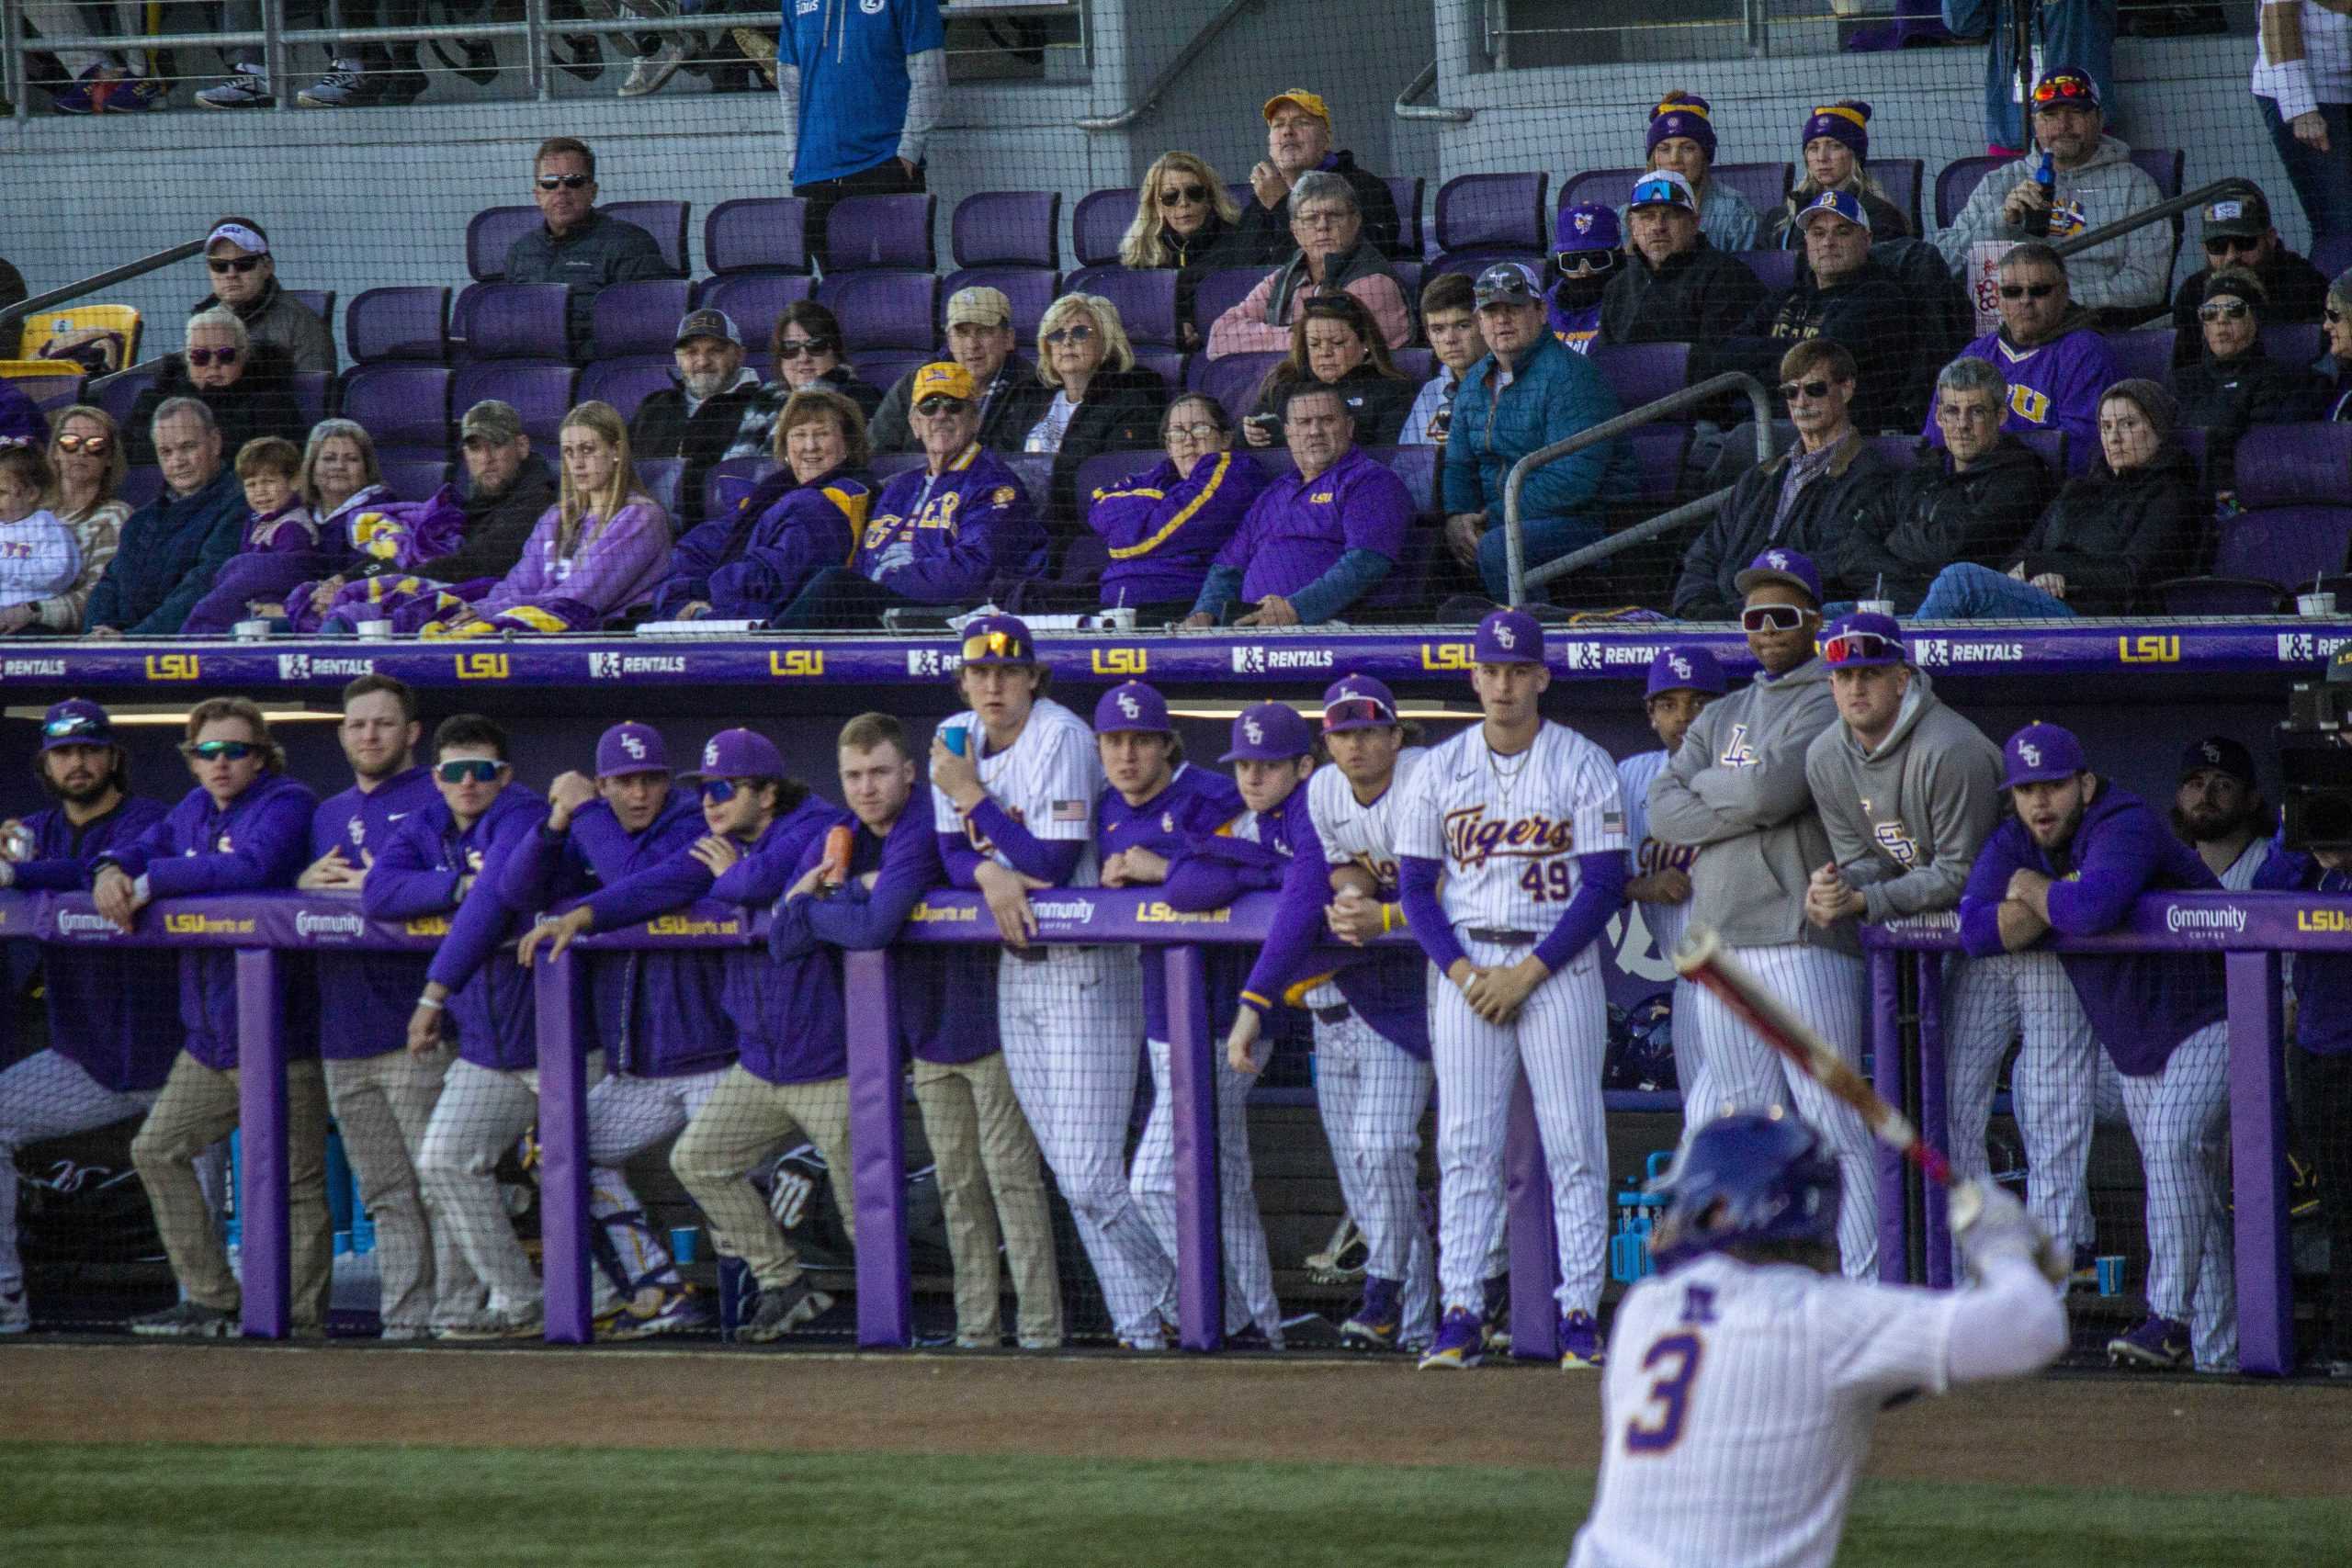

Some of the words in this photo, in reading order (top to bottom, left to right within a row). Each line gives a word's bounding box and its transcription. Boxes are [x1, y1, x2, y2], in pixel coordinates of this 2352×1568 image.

[1092, 649, 1148, 674] LSU
[1232, 647, 1265, 672] H&E
[1268, 651, 1333, 668] RENTALS
[1422, 644, 1476, 670] LSU
[1567, 642, 1601, 670] H&E
[1915, 639, 1949, 666] H&E
[1952, 644, 2023, 661] RENTALS
[2120, 635, 2180, 662] LSU
[5, 660, 66, 676] RENTALS
[146, 655, 198, 680] LSU
[312, 660, 374, 676] RENTALS
[456, 653, 509, 679] LSU
[623, 657, 685, 673] RENTALS
[770, 650, 824, 676] LSU
[1444, 805, 1573, 871] Tigers
[1521, 860, 1571, 903] 49
[2166, 904, 2247, 933] Community
[1624, 1332, 1708, 1459] 3
